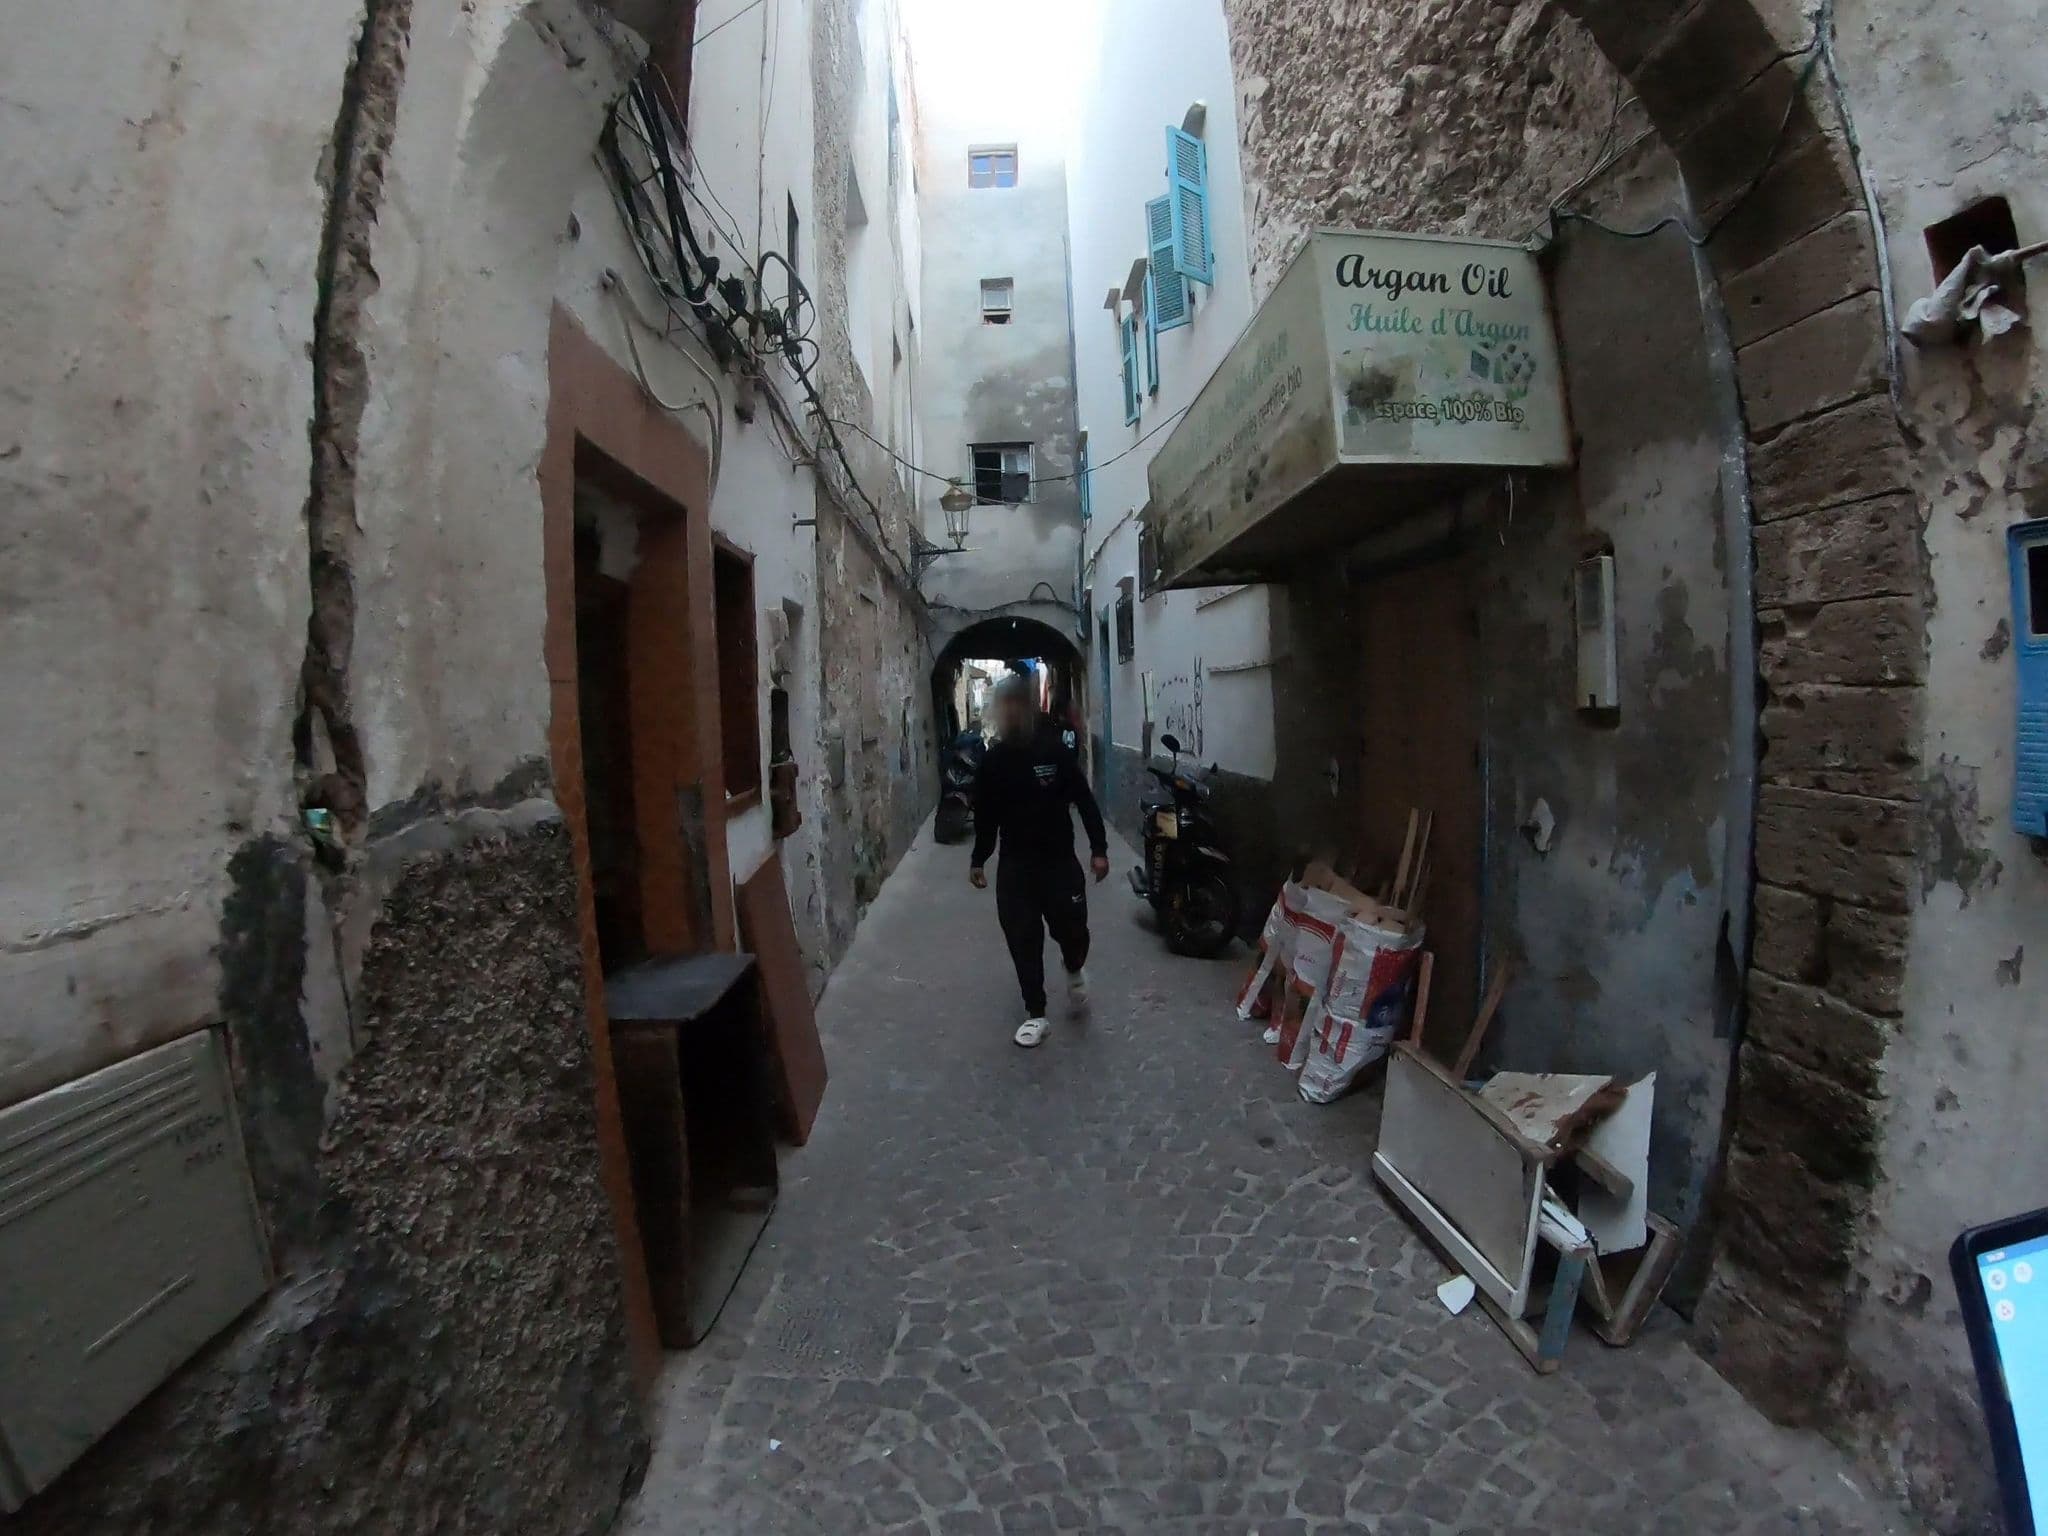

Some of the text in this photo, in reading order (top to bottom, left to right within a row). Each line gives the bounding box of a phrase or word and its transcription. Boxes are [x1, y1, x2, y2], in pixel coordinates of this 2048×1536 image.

[1336, 254, 1512, 301] Argan Oil
[1347, 303, 1529, 344] Huile d'Argan
[1440, 397, 1493, 421] 100%
[1495, 401, 1525, 423] Bio
